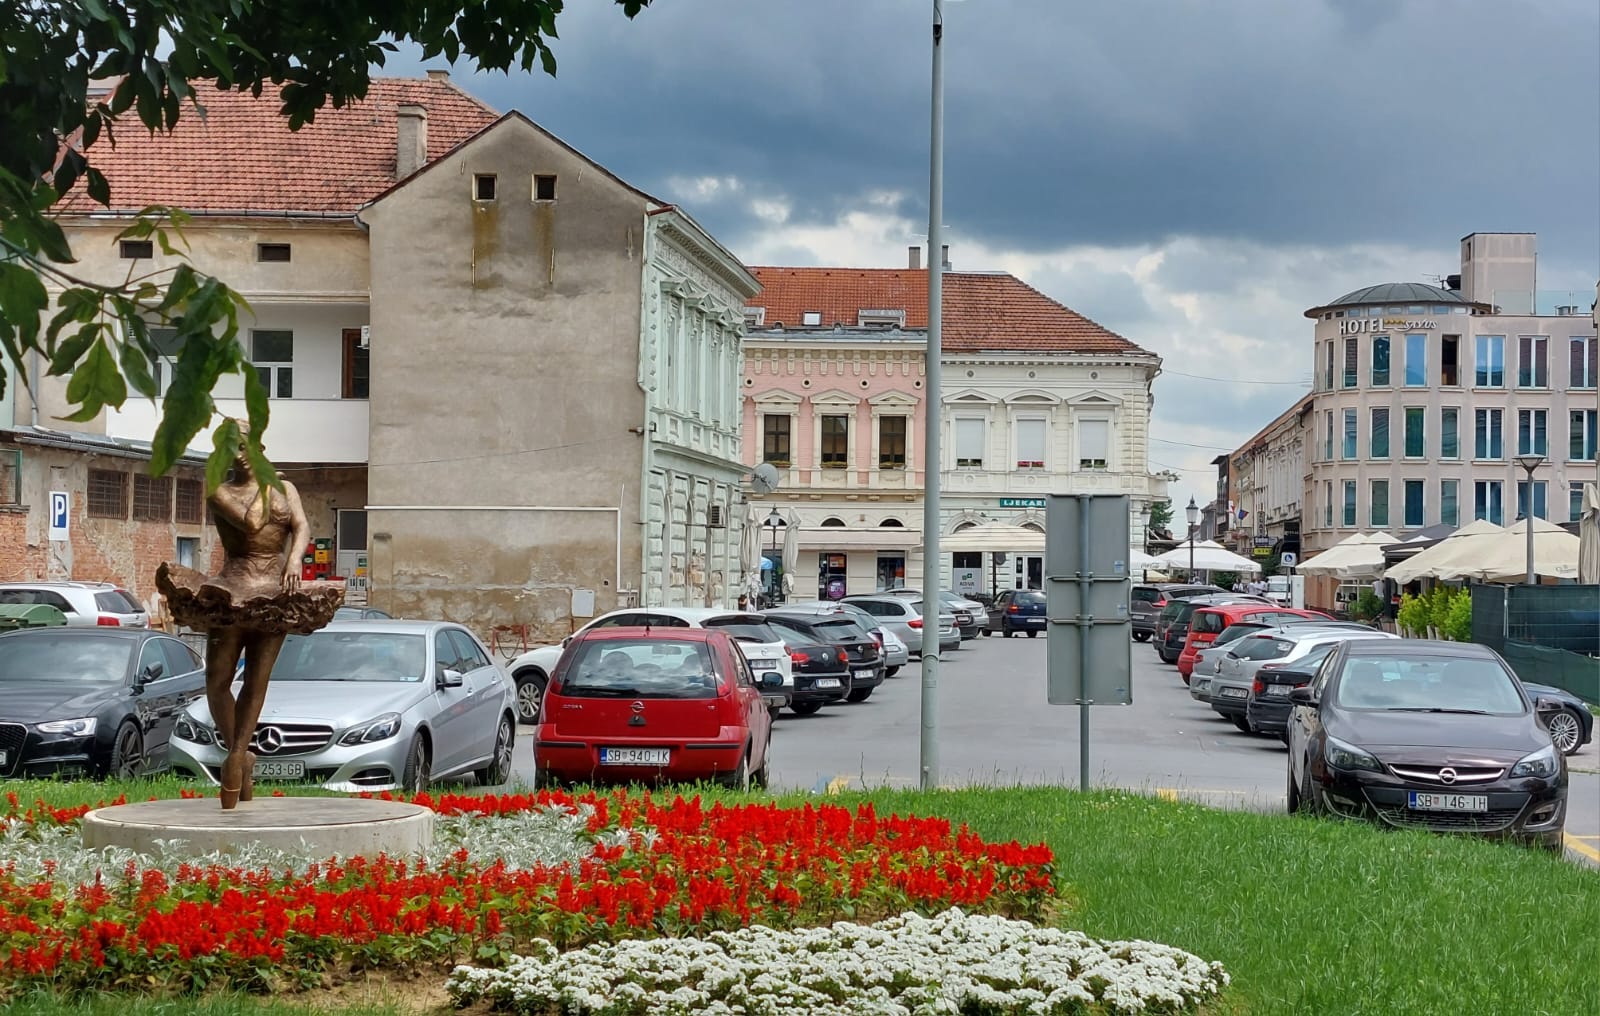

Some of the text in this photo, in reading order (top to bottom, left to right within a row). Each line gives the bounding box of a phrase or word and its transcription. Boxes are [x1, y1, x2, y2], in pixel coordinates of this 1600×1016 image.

[1339, 319, 1386, 334] HOTEL
[55, 495, 65, 526] P
[608, 750, 669, 762] SB 940-IK
[261, 763, 302, 776] 253-GB
[1417, 794, 1486, 809] SB 146-IH
